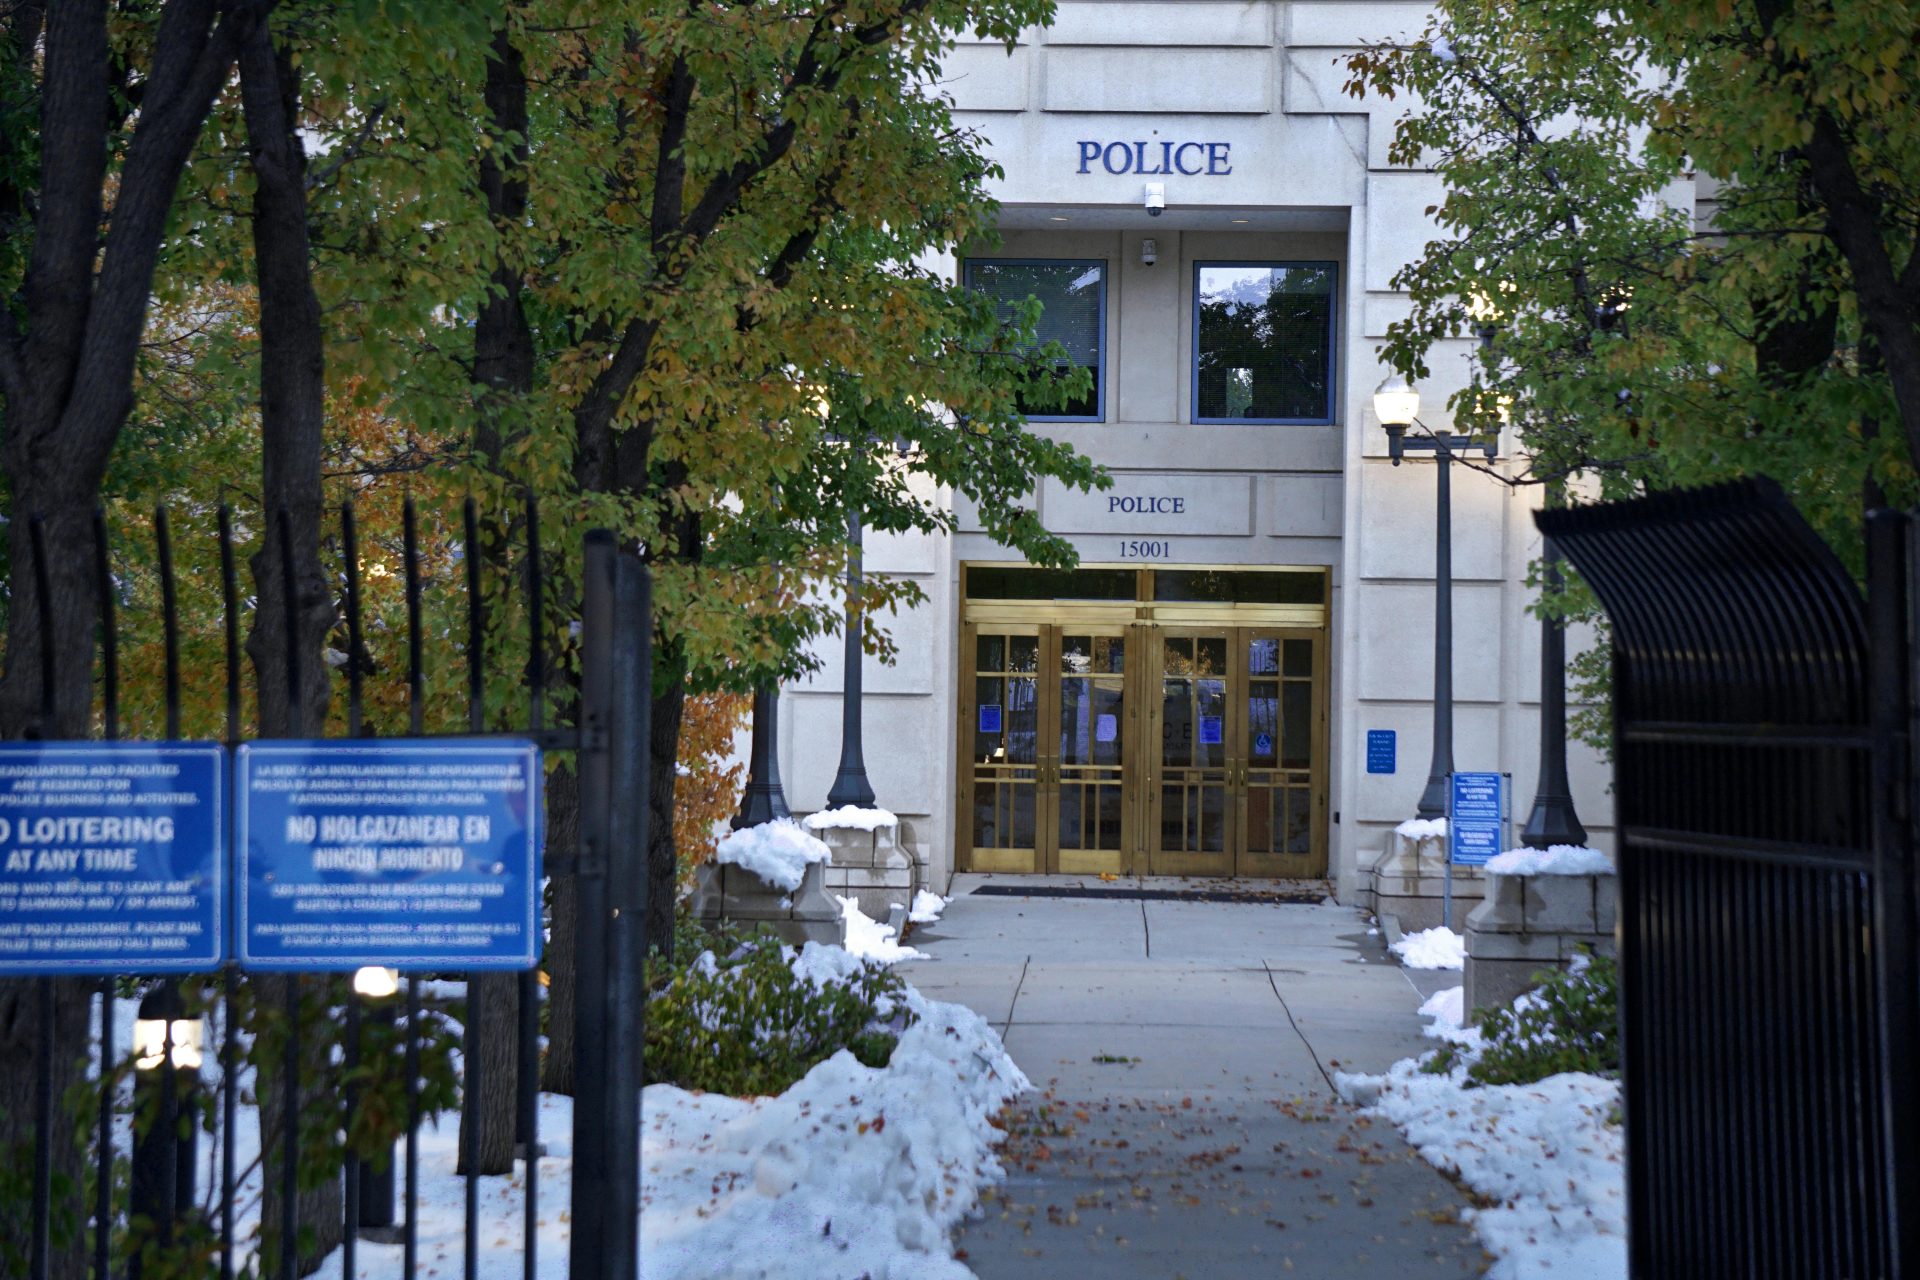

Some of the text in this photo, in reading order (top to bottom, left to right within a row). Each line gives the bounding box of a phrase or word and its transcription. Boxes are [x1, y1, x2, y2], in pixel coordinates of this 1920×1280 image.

[1076, 141, 1233, 176] POLICE
[1107, 496, 1186, 513] POLICE
[1120, 541, 1169, 558] 15001
[90, 764, 116, 777] AND
[118, 764, 180, 777] FACILITIES
[13, 779, 131, 791] ARE RESERVED FOR
[45, 793, 104, 806] BUSINESS
[106, 793, 132, 806] AND
[18, 816, 175, 843] LOITERING
[286, 815, 490, 843] NO HOLGAZANEAR EN
[6, 849, 138, 872] AT ANY TIME
[379, 847, 463, 872] MOMENTO
[86, 896, 115, 911] AND
